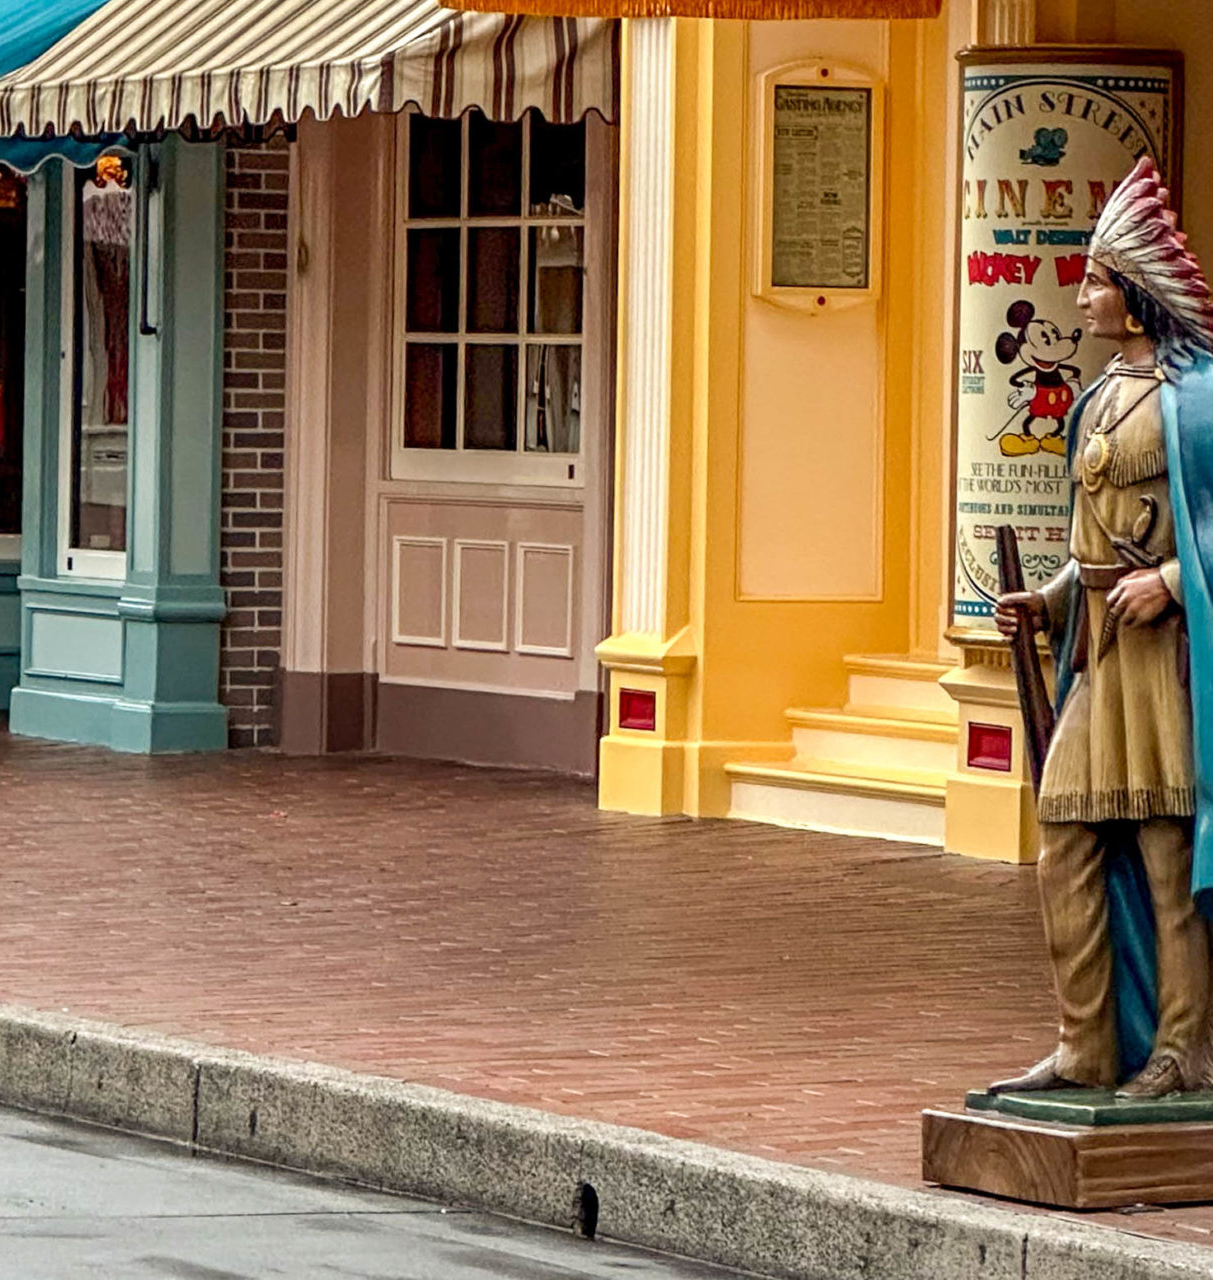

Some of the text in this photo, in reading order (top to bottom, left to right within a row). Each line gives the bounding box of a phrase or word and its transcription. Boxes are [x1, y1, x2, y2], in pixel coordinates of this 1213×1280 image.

[966, 91, 1149, 161] MAIN STREET
[962, 350, 985, 374] SIX
[1025, 480, 1064, 495] MOST
